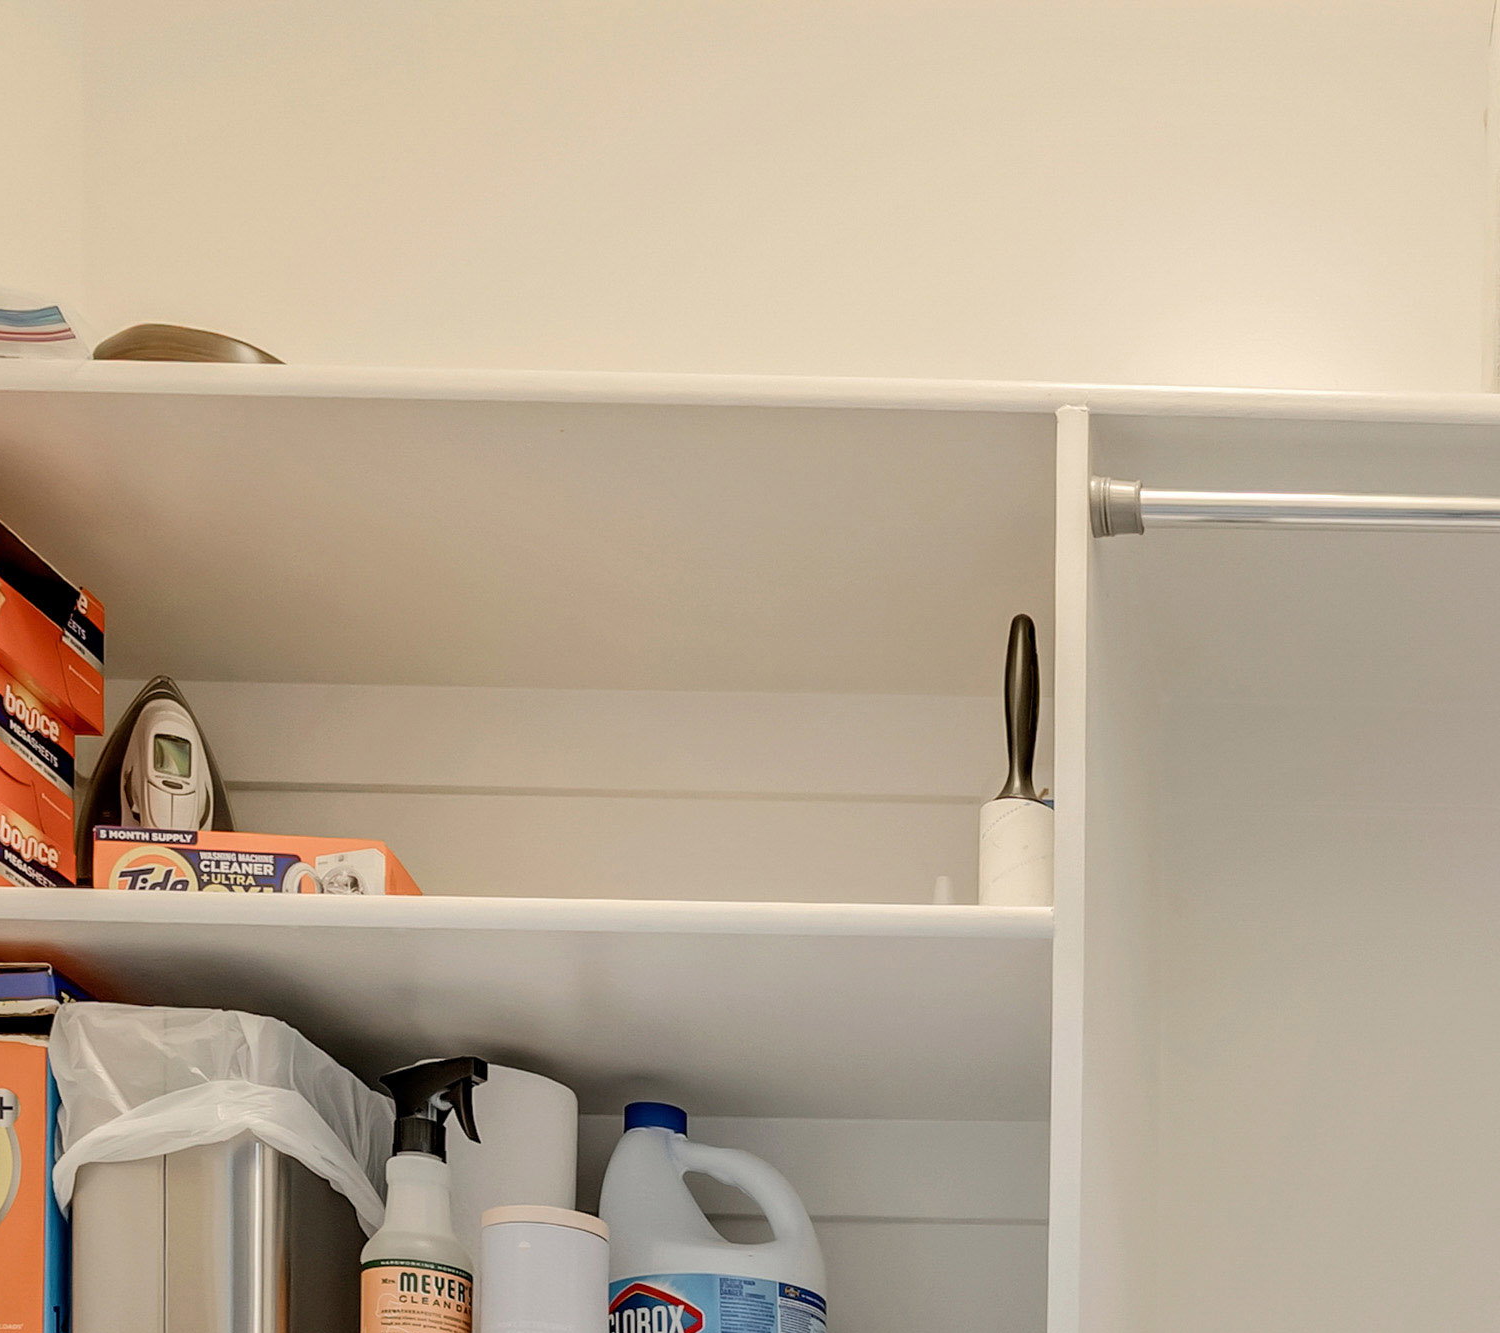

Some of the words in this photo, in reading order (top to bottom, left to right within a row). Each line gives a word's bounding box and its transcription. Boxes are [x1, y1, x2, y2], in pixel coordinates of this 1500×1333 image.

[3, 684, 60, 742] bounce
[100, 829, 107, 839] 5
[109, 830, 150, 841] MONTH
[152, 832, 192, 843] SUPPLY
[200, 852, 236, 862] WASHING
[200, 861, 274, 876] CLEANER
[398, 1294, 452, 1310] CLEAN
